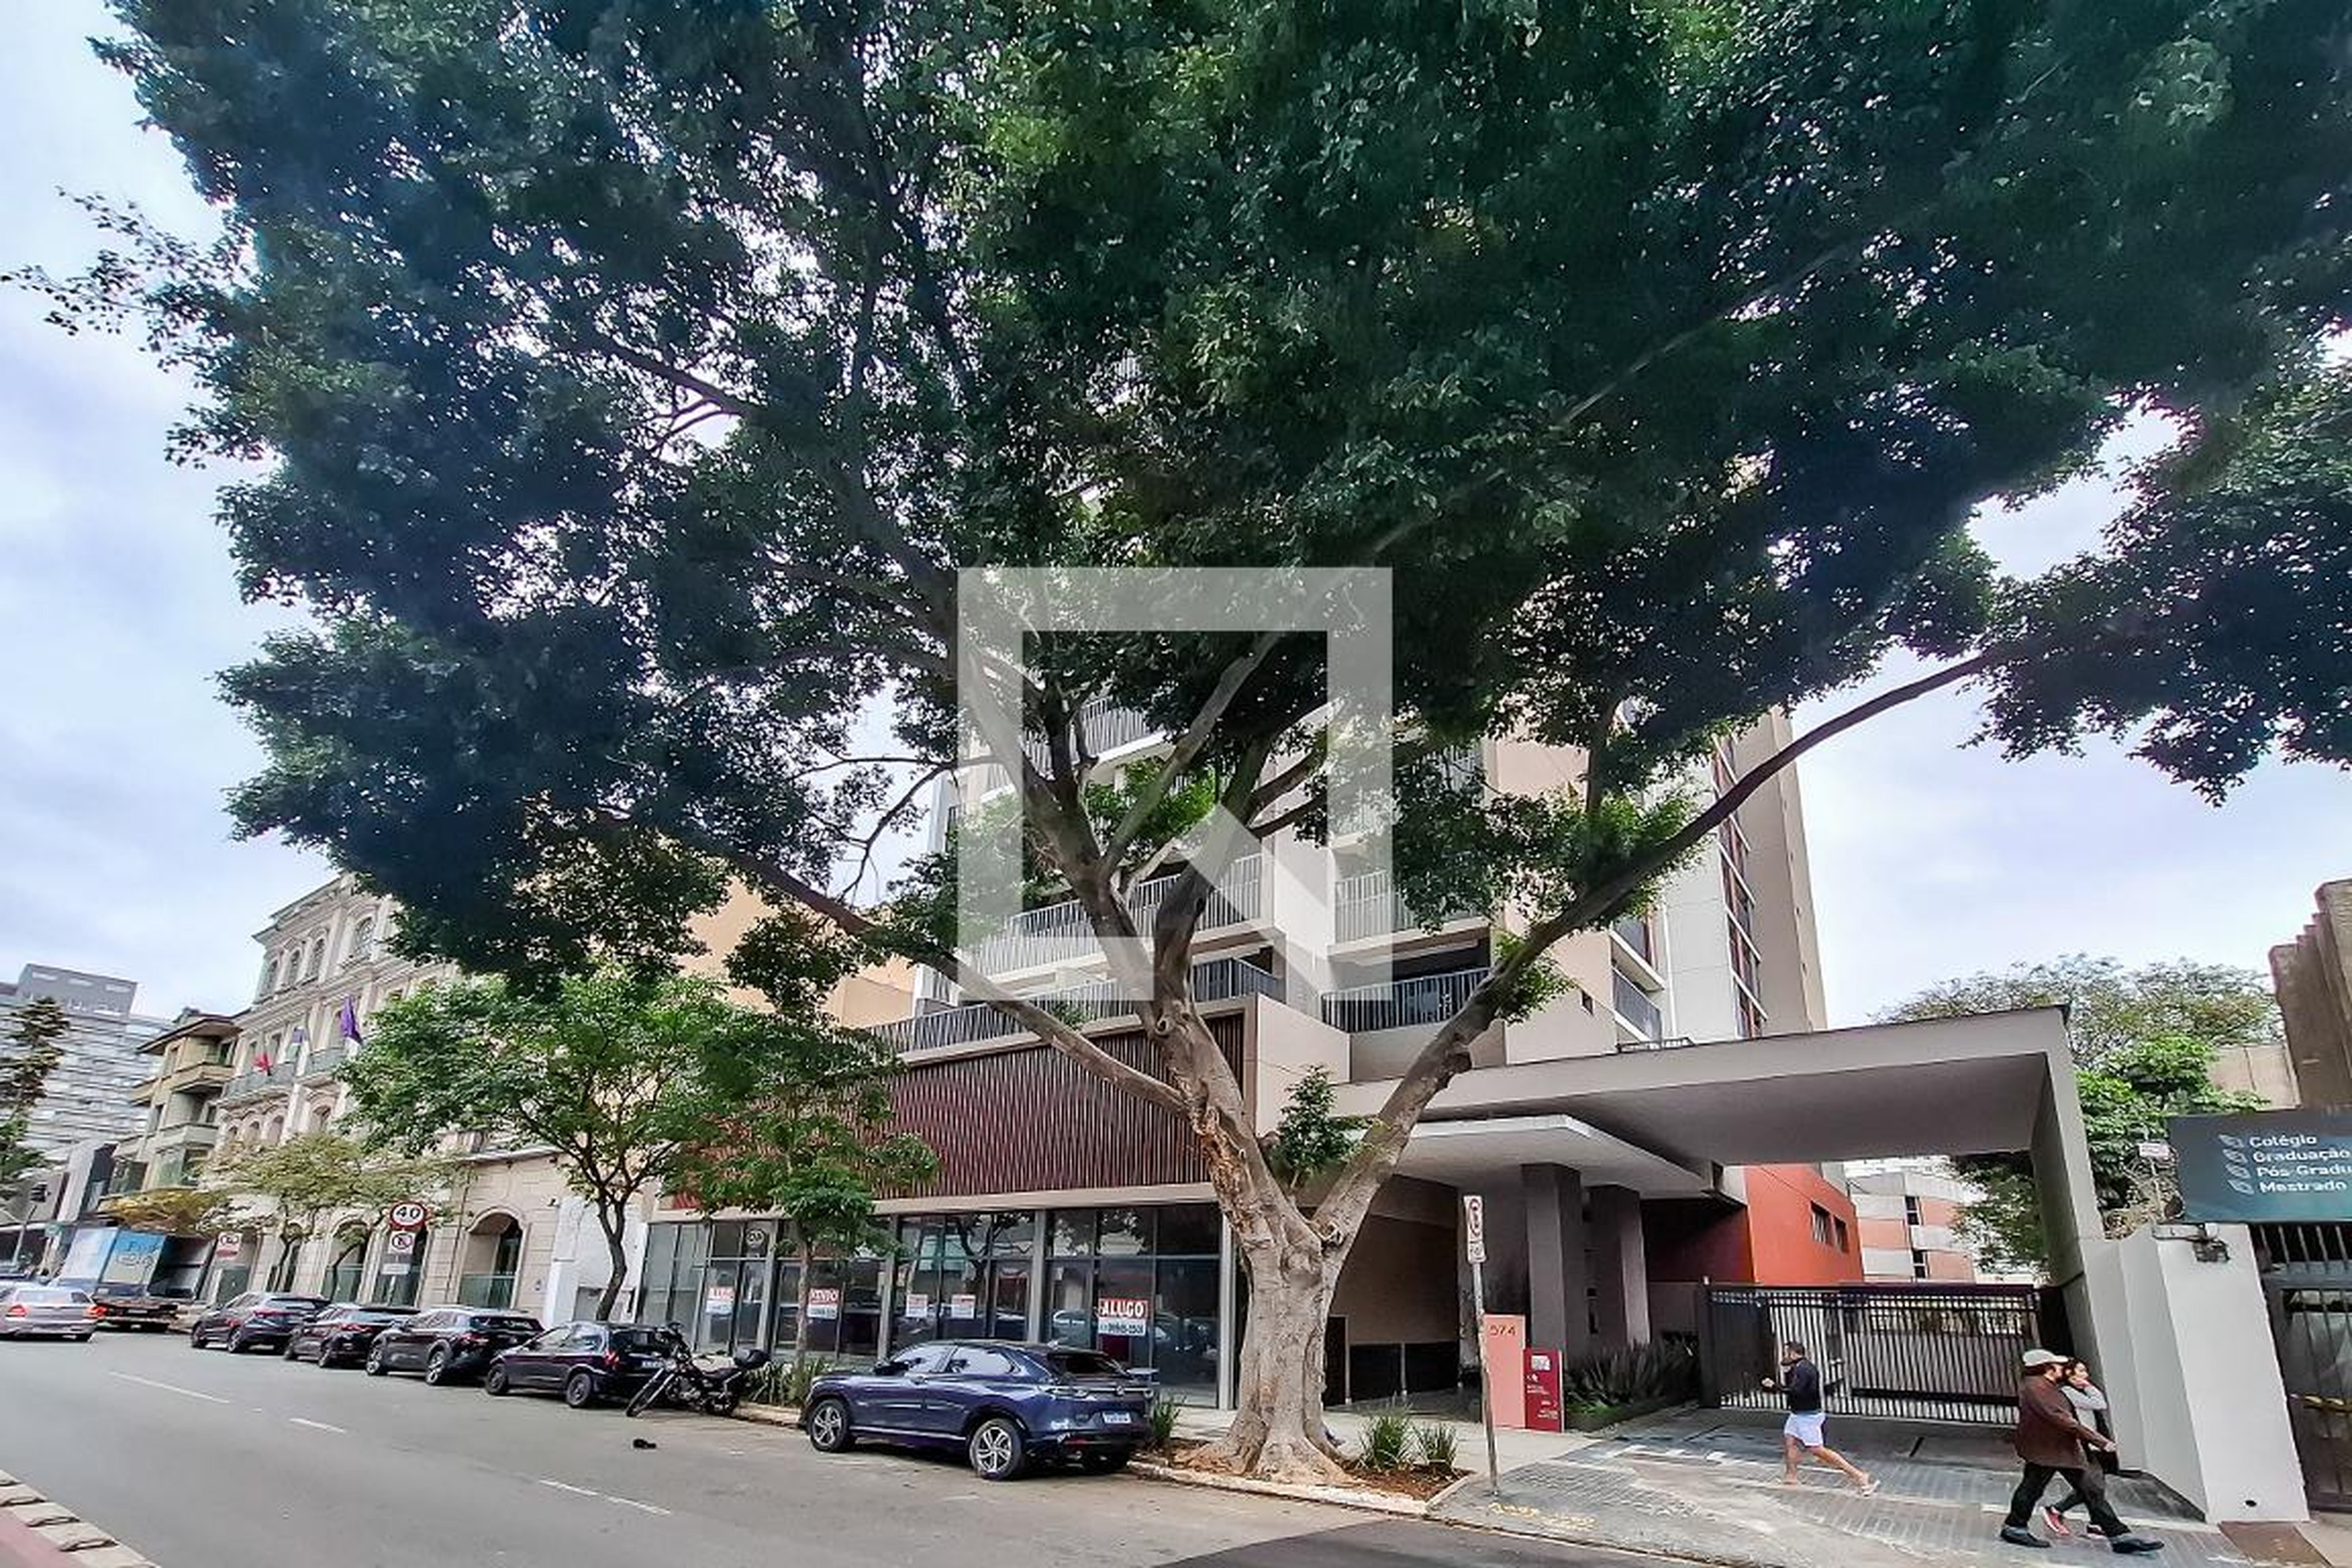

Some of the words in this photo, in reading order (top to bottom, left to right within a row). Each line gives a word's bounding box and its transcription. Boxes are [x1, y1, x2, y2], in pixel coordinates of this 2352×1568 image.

[2249, 1135, 2317, 1147] Colégio
[2253, 1147, 2350, 1163] Graduação
[2260, 1180, 2347, 1193] Mestrado
[396, 1205, 421, 1219] 40
[1099, 1300, 1144, 1317] ALUGO
